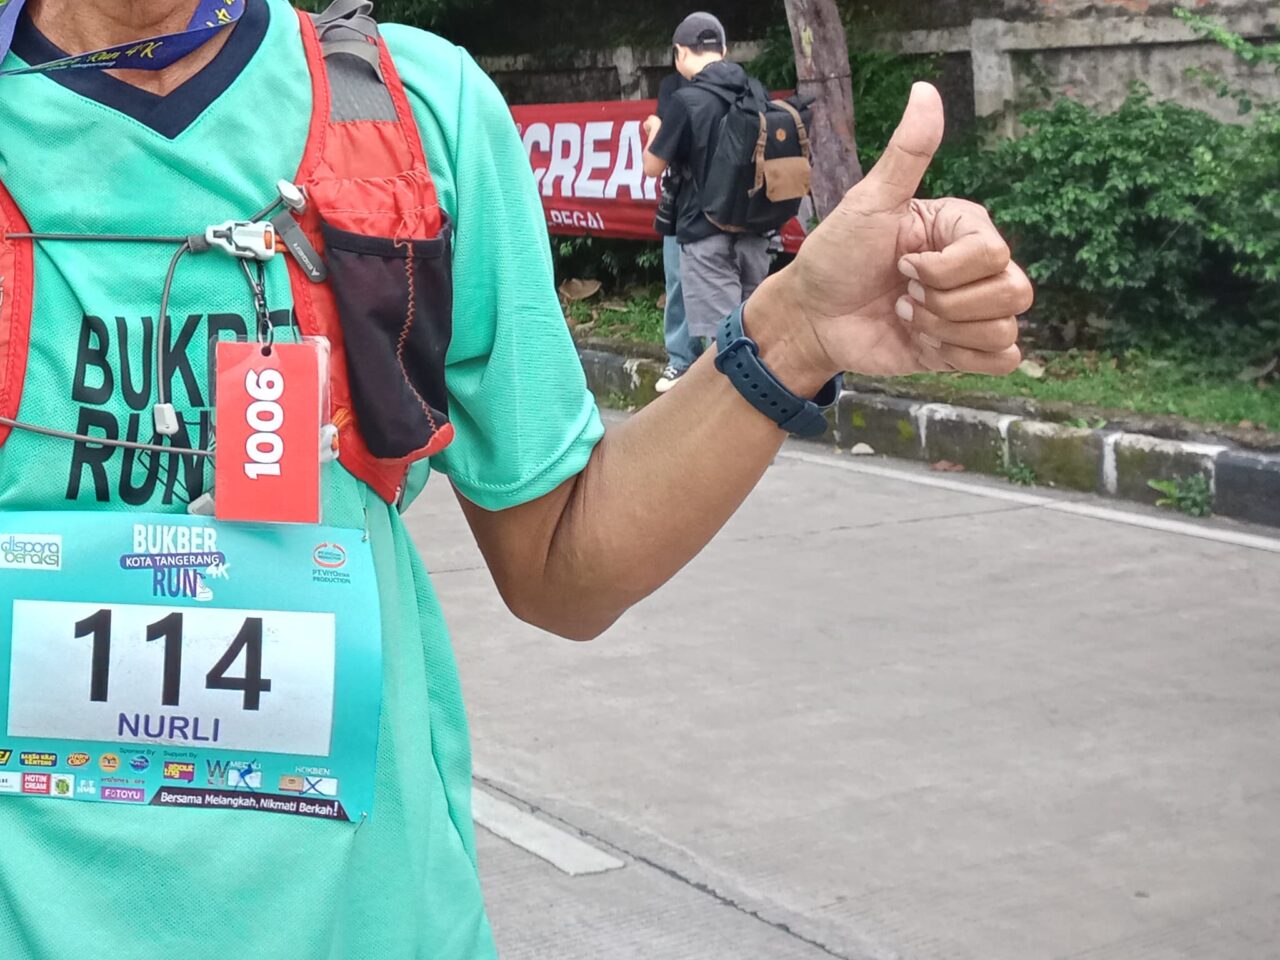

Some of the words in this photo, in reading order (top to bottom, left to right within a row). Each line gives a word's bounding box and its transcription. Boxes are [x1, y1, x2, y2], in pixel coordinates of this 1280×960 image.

[522, 120, 666, 200] CREA
[242, 367, 284, 480] 1006
[133, 524, 217, 554] BUKBER
[126, 557, 153, 567] KOTA
[155, 554, 220, 567] TANGERANG
[206, 562, 231, 581] 4K
[153, 568, 198, 598] RUN
[74, 608, 272, 711] 114
[118, 712, 220, 743] NURLI
[160, 793, 202, 804] Bersama
[204, 795, 259, 809] Melangkah,
[260, 798, 297, 812] Nikmati
[299, 802, 339, 817] Berkah!
